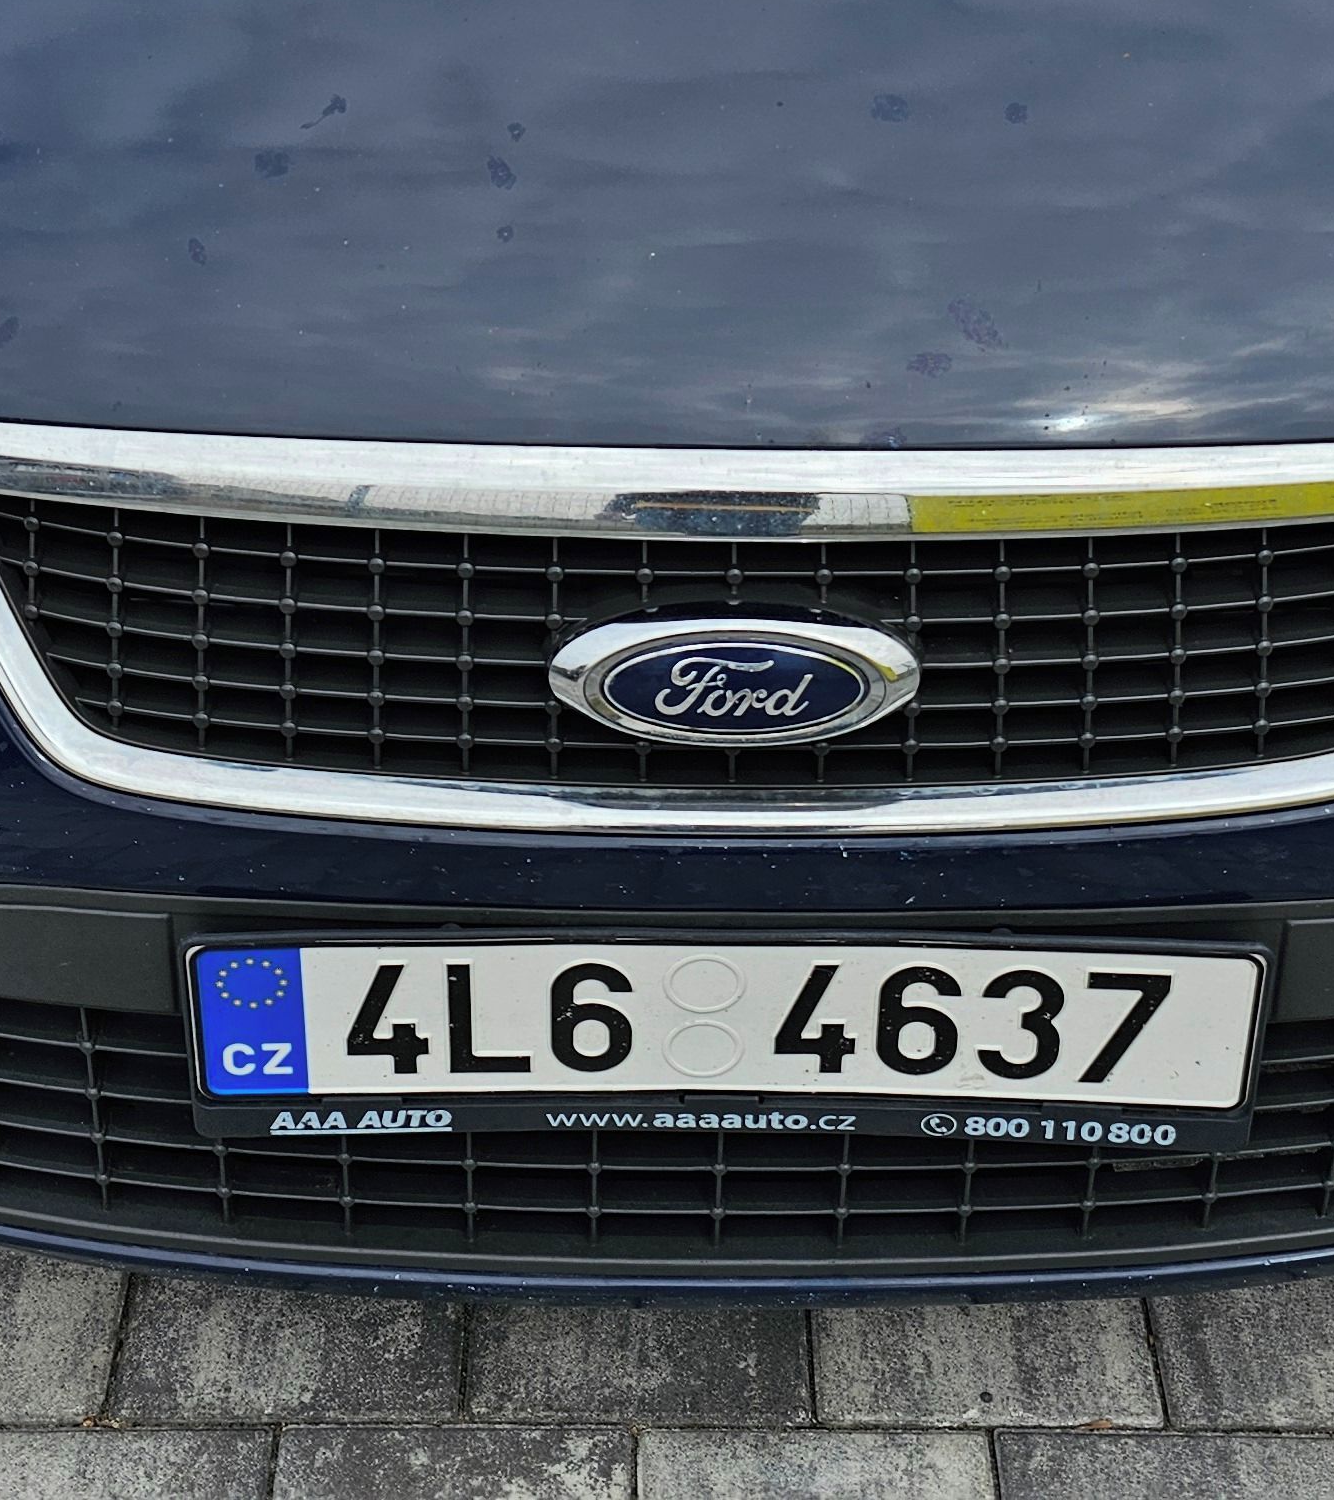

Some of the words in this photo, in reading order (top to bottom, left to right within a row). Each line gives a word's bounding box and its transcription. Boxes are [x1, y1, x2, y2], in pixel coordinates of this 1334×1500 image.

[654, 656, 814, 717] Ford
[347, 962, 633, 1074] 4L6
[773, 964, 1173, 1084] 4637
[222, 1042, 294, 1075] CZ
[270, 1111, 345, 1130] AAA
[357, 1109, 453, 1129] AUTO
[545, 1111, 856, 1131] www.aaaauto.cz
[964, 1116, 1029, 1139] 800
[1040, 1118, 1103, 1143] 110
[1107, 1120, 1177, 1146] 800
